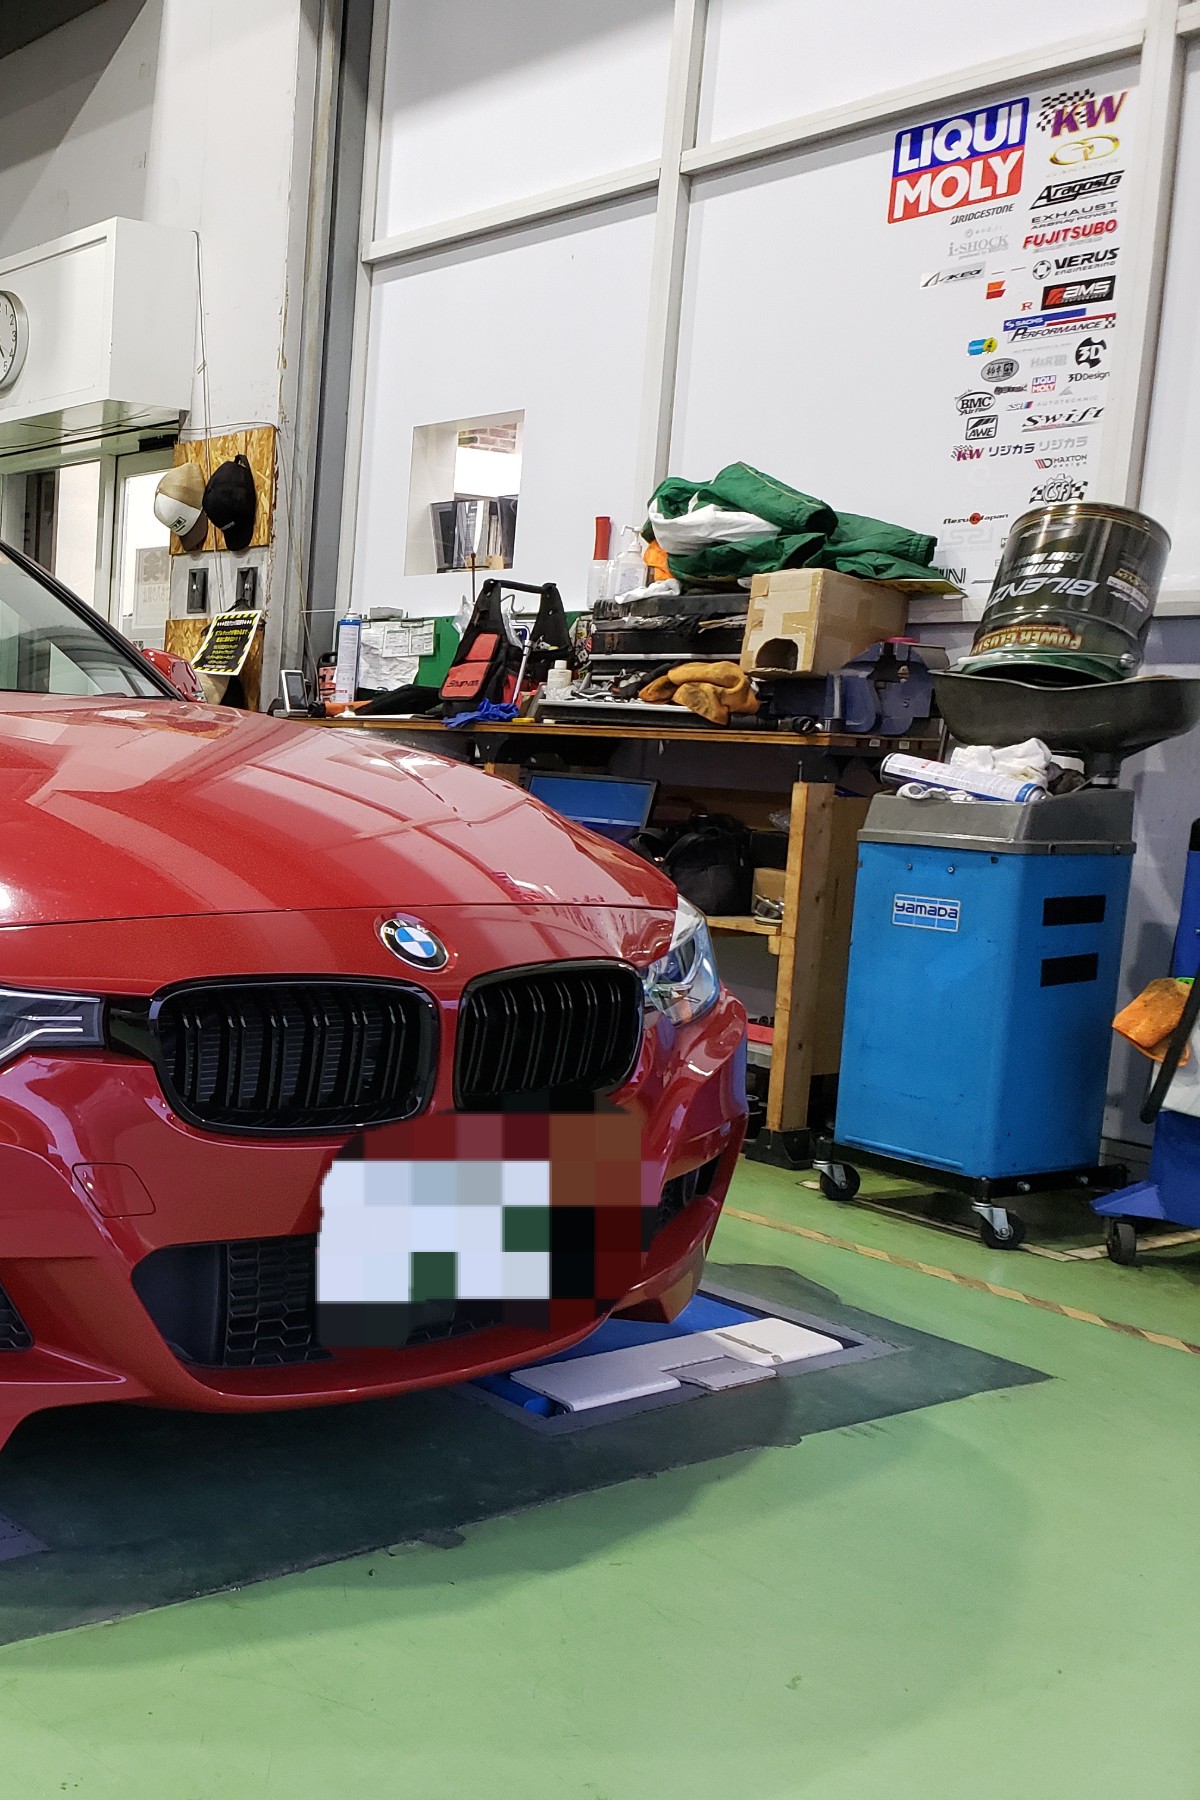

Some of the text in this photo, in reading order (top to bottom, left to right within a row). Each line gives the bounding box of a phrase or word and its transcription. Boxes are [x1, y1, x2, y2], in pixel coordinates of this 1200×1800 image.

[1050, 91, 1128, 139] KW
[897, 102, 1024, 173] LIQUI
[893, 150, 1024, 220] MOLY
[950, 203, 1015, 225] BRIDGESTONE
[1031, 200, 1118, 223] EXHAUST
[1022, 219, 1117, 250] FUJITSUBO
[1054, 246, 1120, 269] VERUS
[1054, 260, 1116, 276] ENGINEERING
[1011, 320, 1103, 341] PERFORMANCE
[1078, 345, 1101, 361] 3D
[1032, 375, 1056, 384] LIQUI
[1031, 383, 1055, 393] MOLY
[960, 397, 992, 409] BMC
[968, 426, 995, 438] AWE
[988, 443, 1035, 457] リジカラ
[1039, 436, 1088, 452] リジカラ
[957, 447, 985, 461] KW
[1053, 454, 1087, 464] MAXTON
[1019, 631, 1082, 650] POWER
[383, 919, 430, 936] BMW
